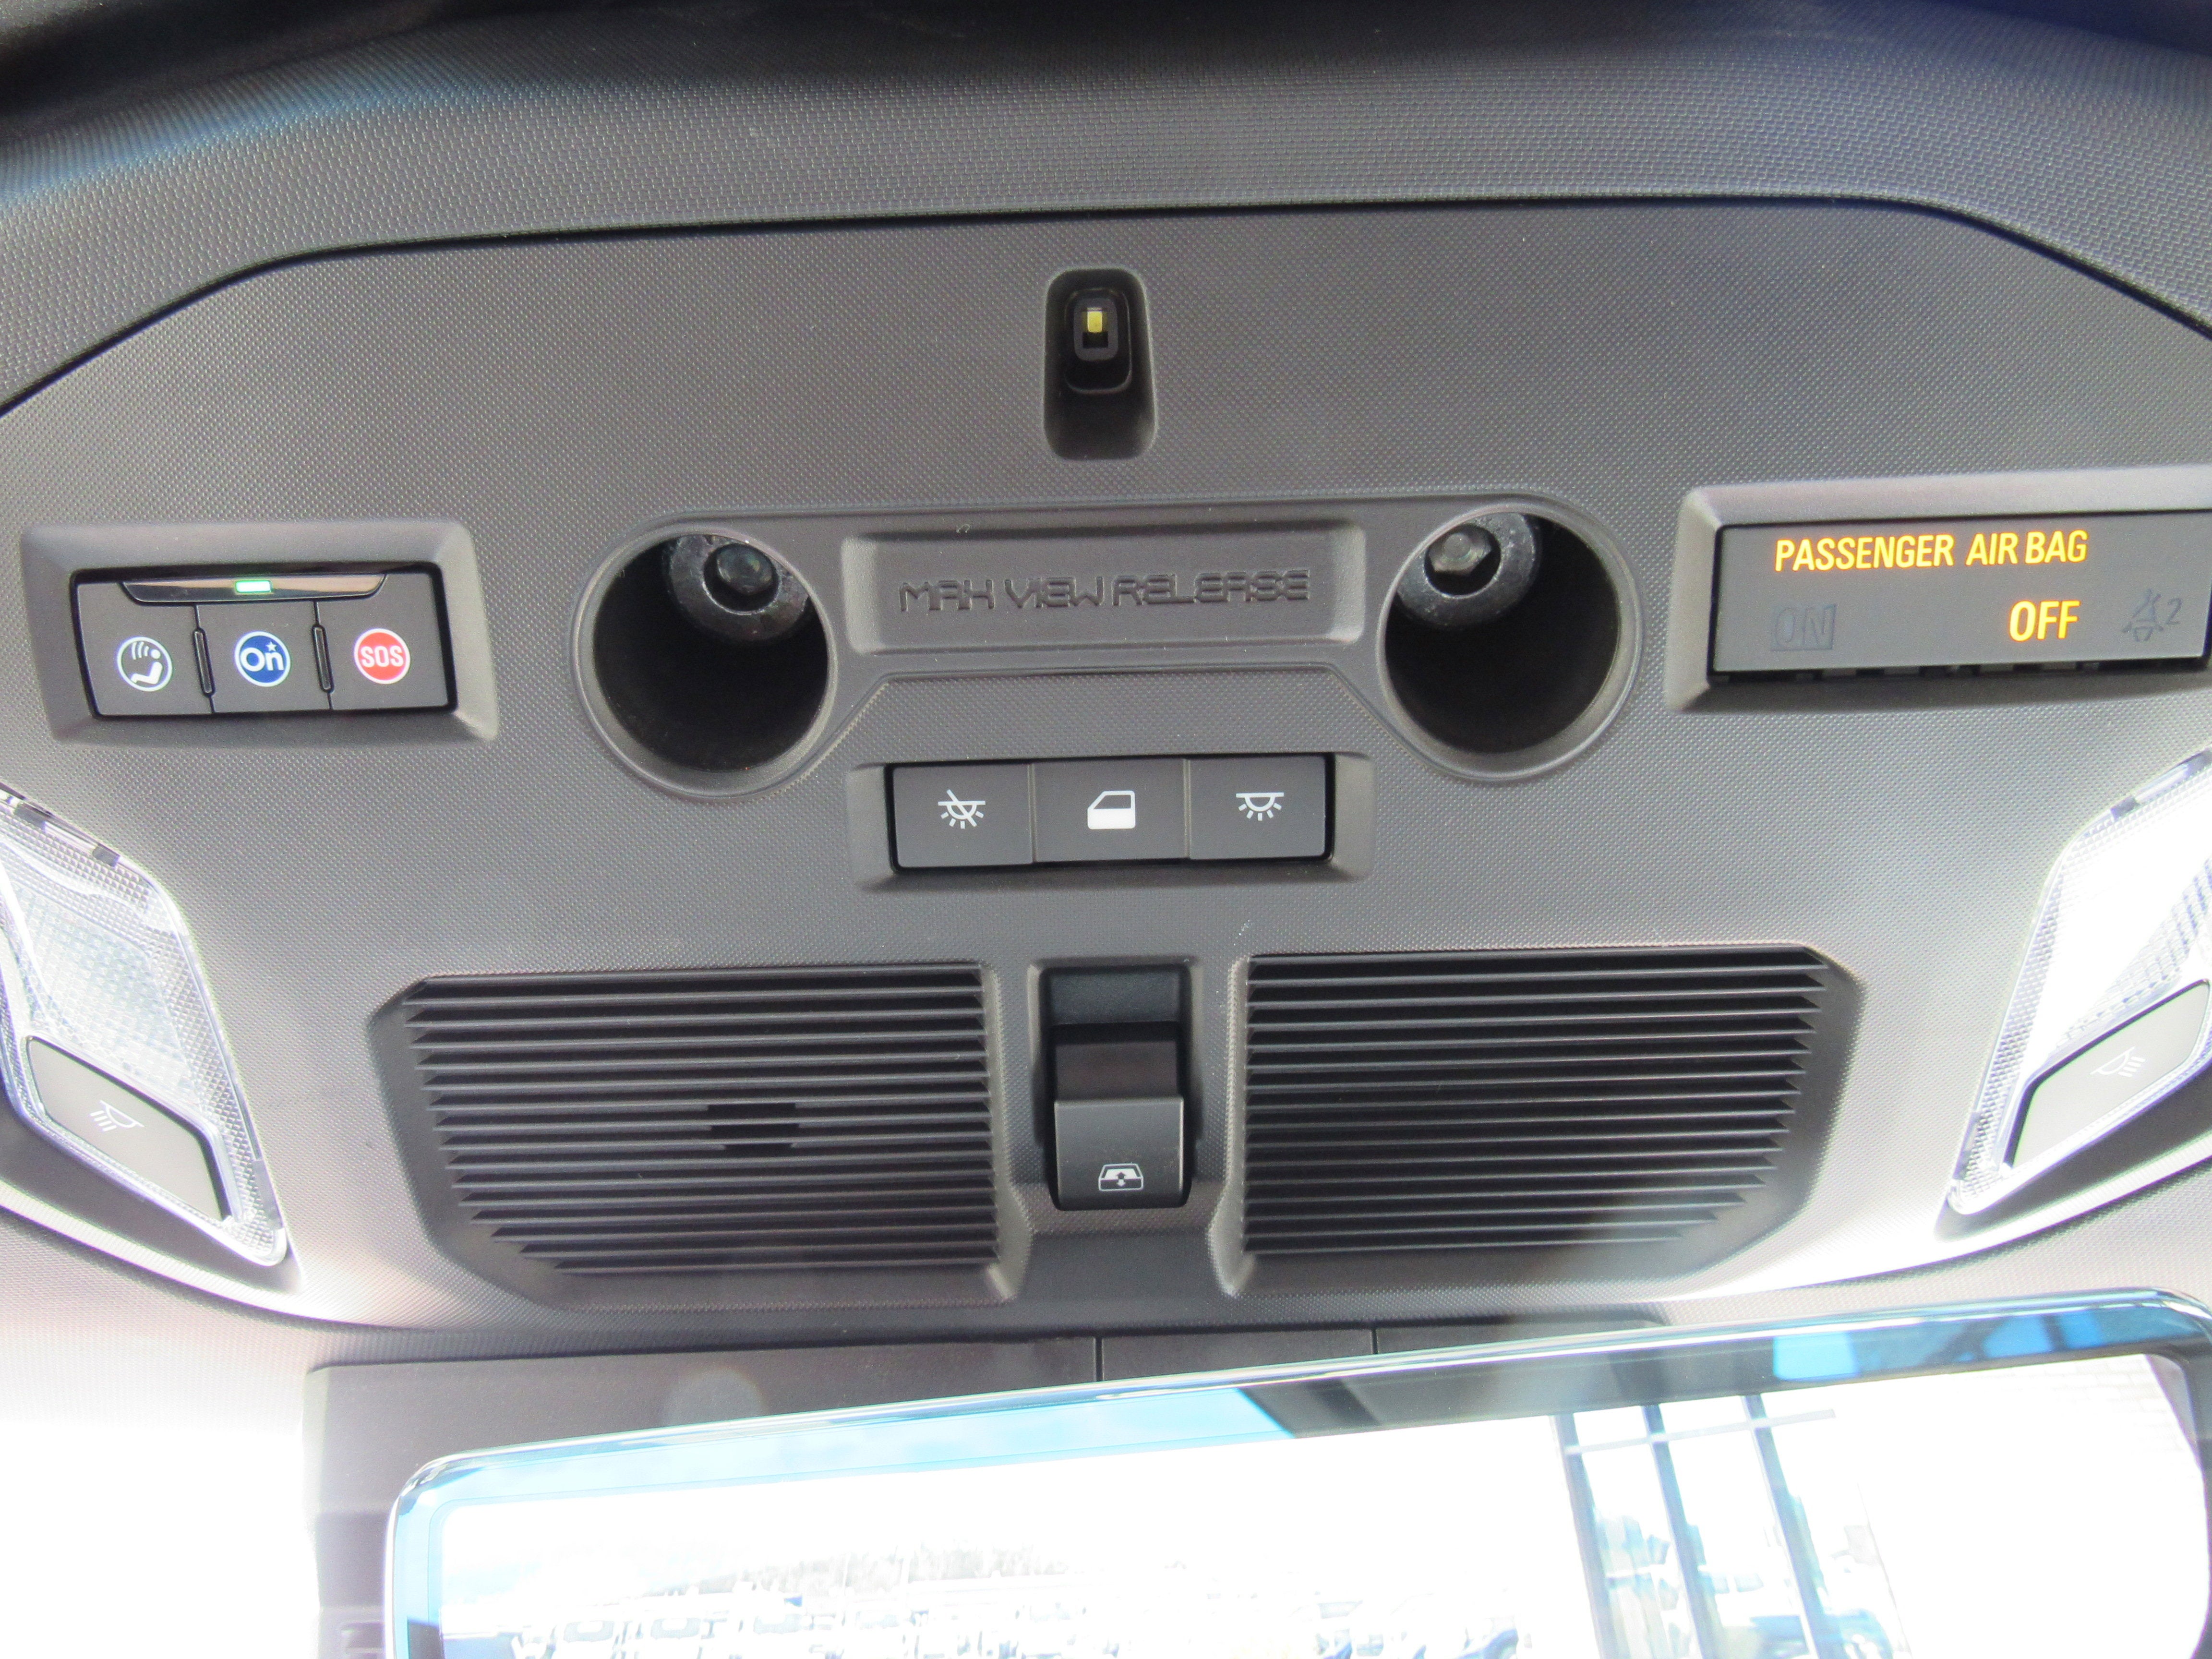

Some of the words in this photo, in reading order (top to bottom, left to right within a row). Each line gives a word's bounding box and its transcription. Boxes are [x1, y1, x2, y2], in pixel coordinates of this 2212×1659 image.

[1774, 534, 1955, 572] PASSENGER
[1965, 531, 2018, 566] AIR
[2024, 529, 2089, 565] BAG
[1004, 576, 1104, 609] VIEW
[1113, 569, 1311, 607] RELEASE
[1771, 603, 1836, 650] ON
[2008, 599, 2081, 642] OFF
[2166, 598, 2182, 625] 2
[240, 646, 284, 673] On
[361, 645, 404, 668] SOS
